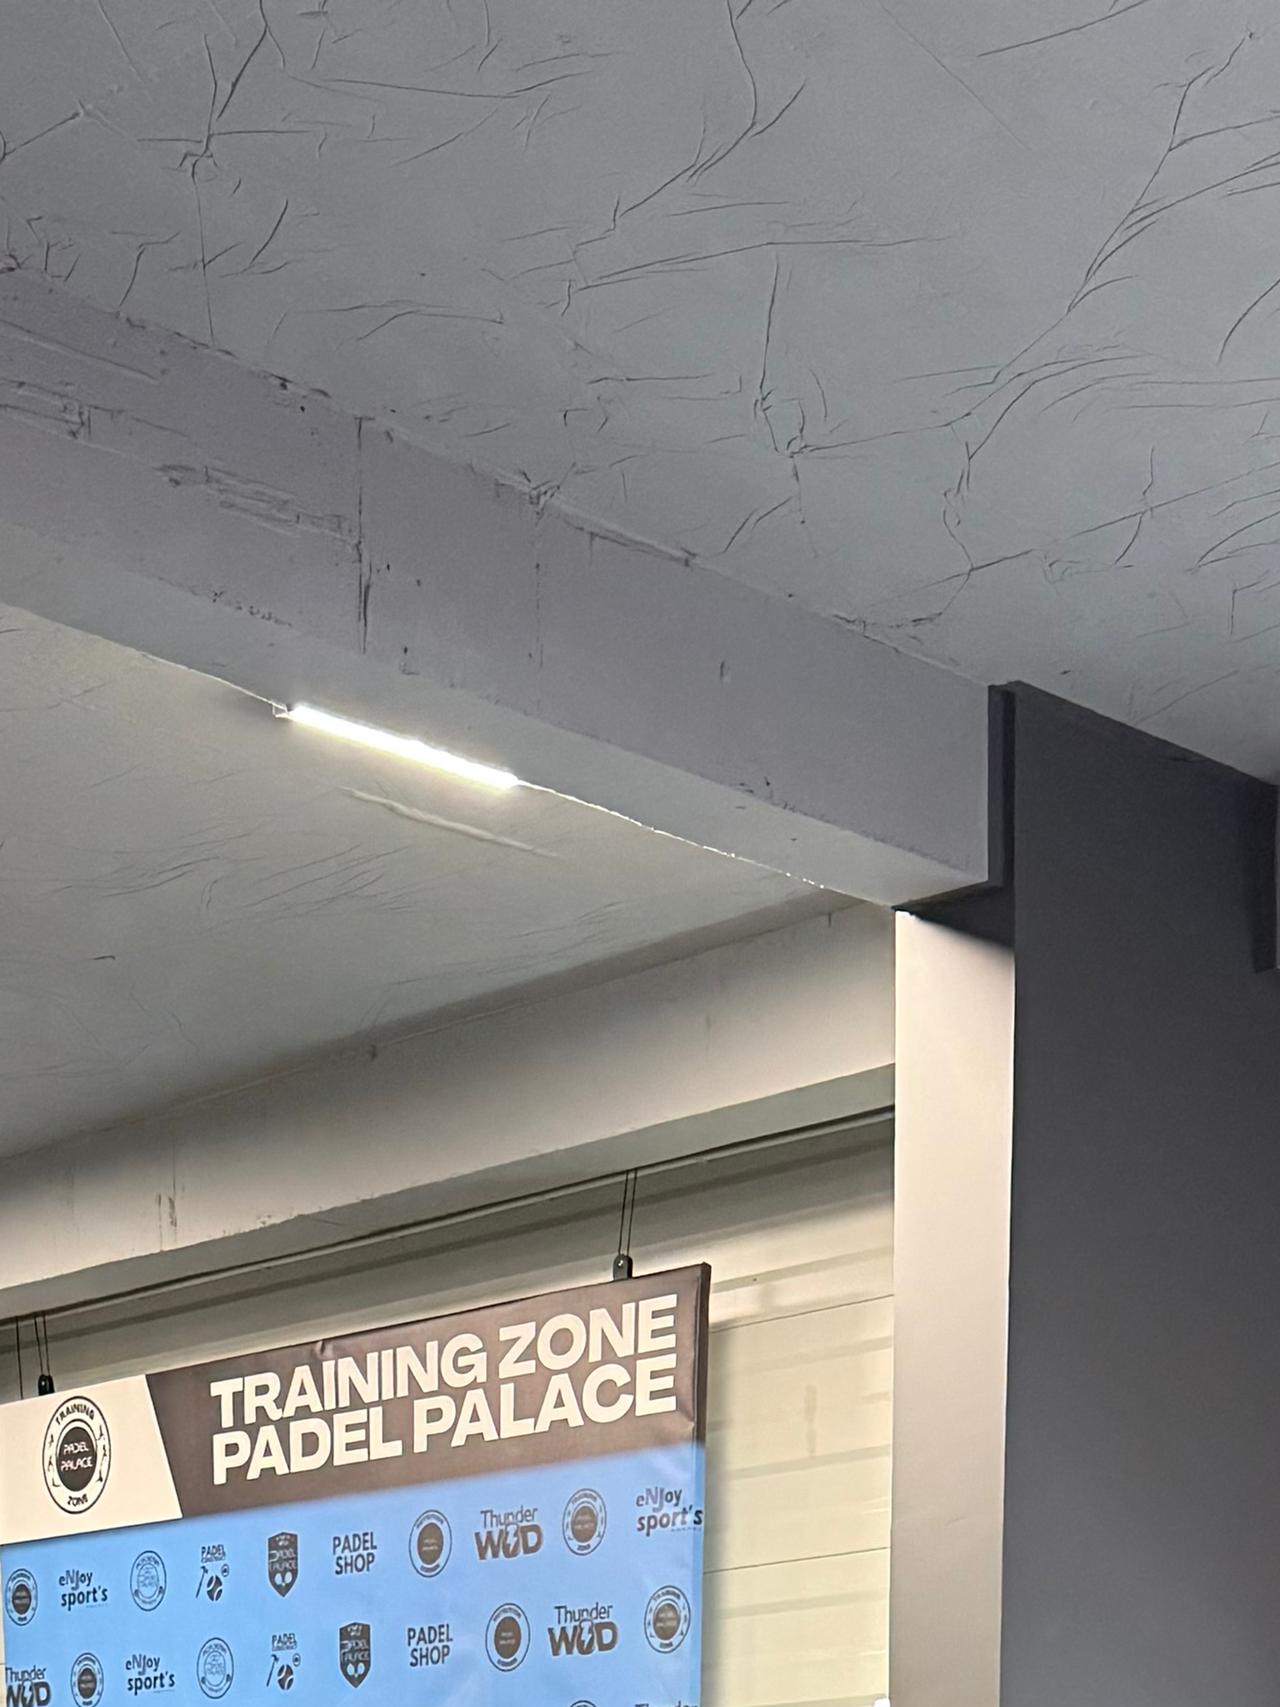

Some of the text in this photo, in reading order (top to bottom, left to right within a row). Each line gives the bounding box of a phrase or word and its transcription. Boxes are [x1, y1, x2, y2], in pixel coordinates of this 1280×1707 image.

[211, 1294, 677, 1429] TRAINING ZONE
[56, 1403, 95, 1425] TRAINING
[213, 1352, 677, 1485] PADEL PALACE
[63, 1442, 88, 1455] PADEL
[61, 1457, 93, 1471] PALACE
[480, 1505, 540, 1531] Thunder
[637, 1502, 703, 1537] sport's
[201, 1544, 226, 1558] PADEL
[333, 1532, 377, 1558] PADEL
[335, 1553, 375, 1575] SHOP
[61, 1583, 107, 1611] sport's
[554, 1602, 616, 1628] Thunder
[272, 1633, 297, 1647] PADEL
[408, 1624, 453, 1646] PADEL
[410, 1645, 450, 1667] SHOP
[5, 1665, 49, 1688] Thunder
[128, 1669, 174, 1696] sport's
